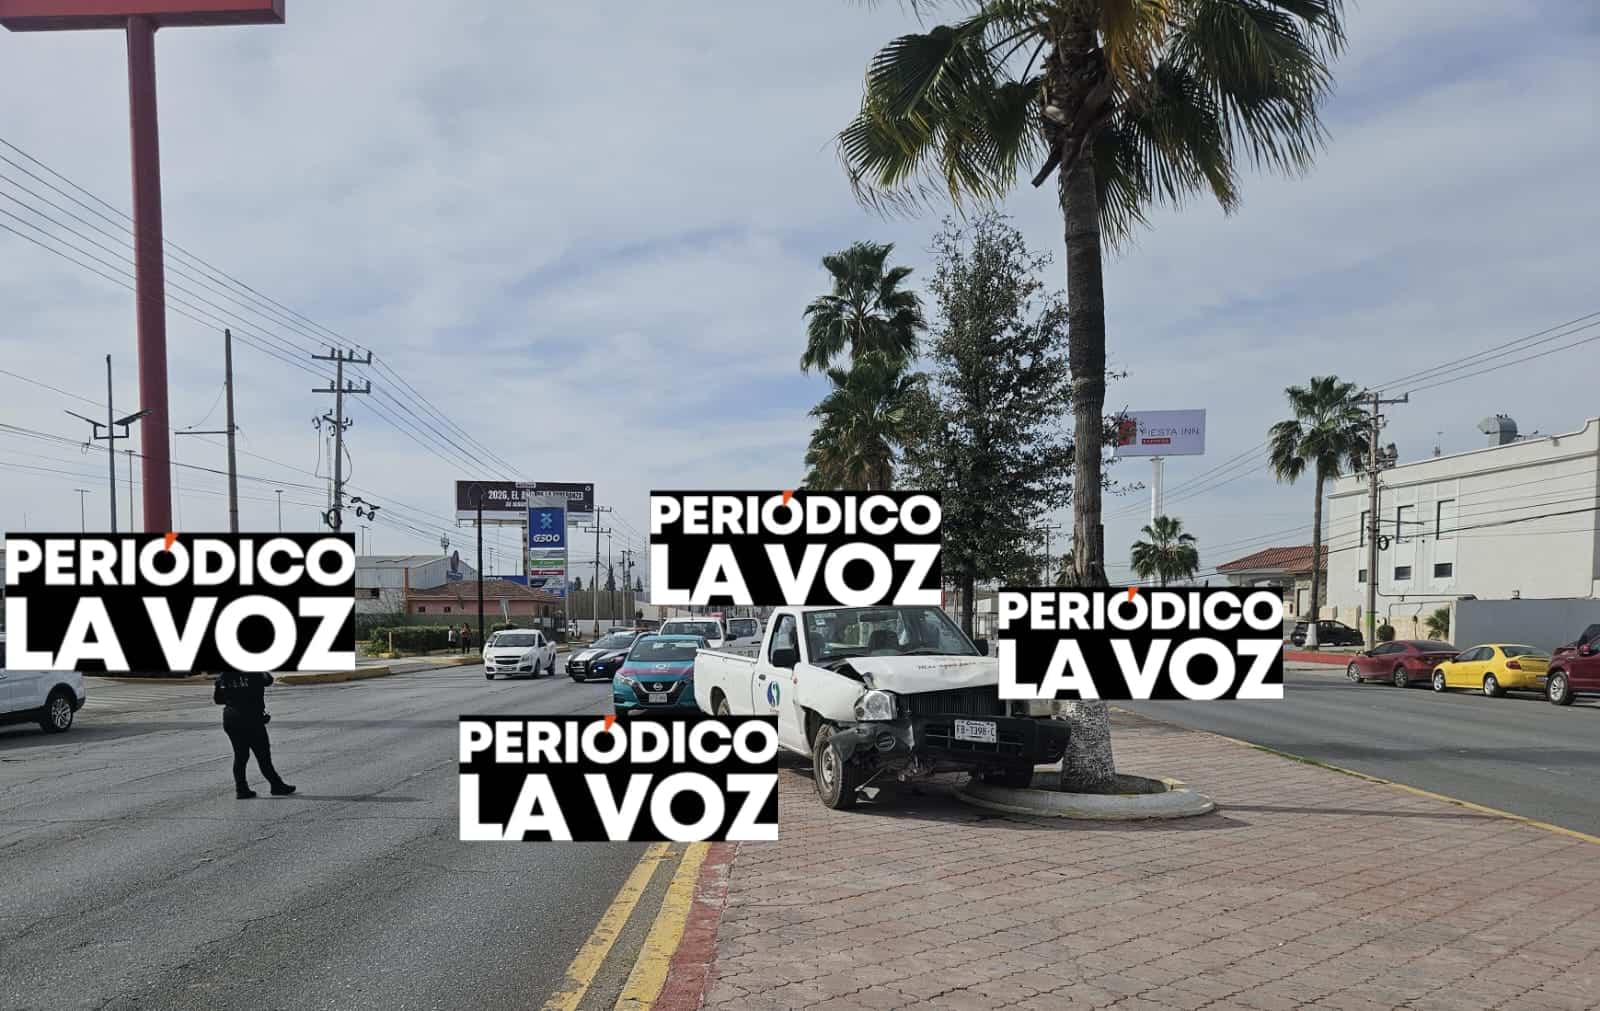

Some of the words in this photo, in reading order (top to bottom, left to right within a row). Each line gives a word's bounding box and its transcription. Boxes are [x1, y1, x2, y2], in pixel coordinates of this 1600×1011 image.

[1181, 427, 1200, 435] INN
[488, 490, 510, 501] 2026,
[511, 490, 519, 499] EL
